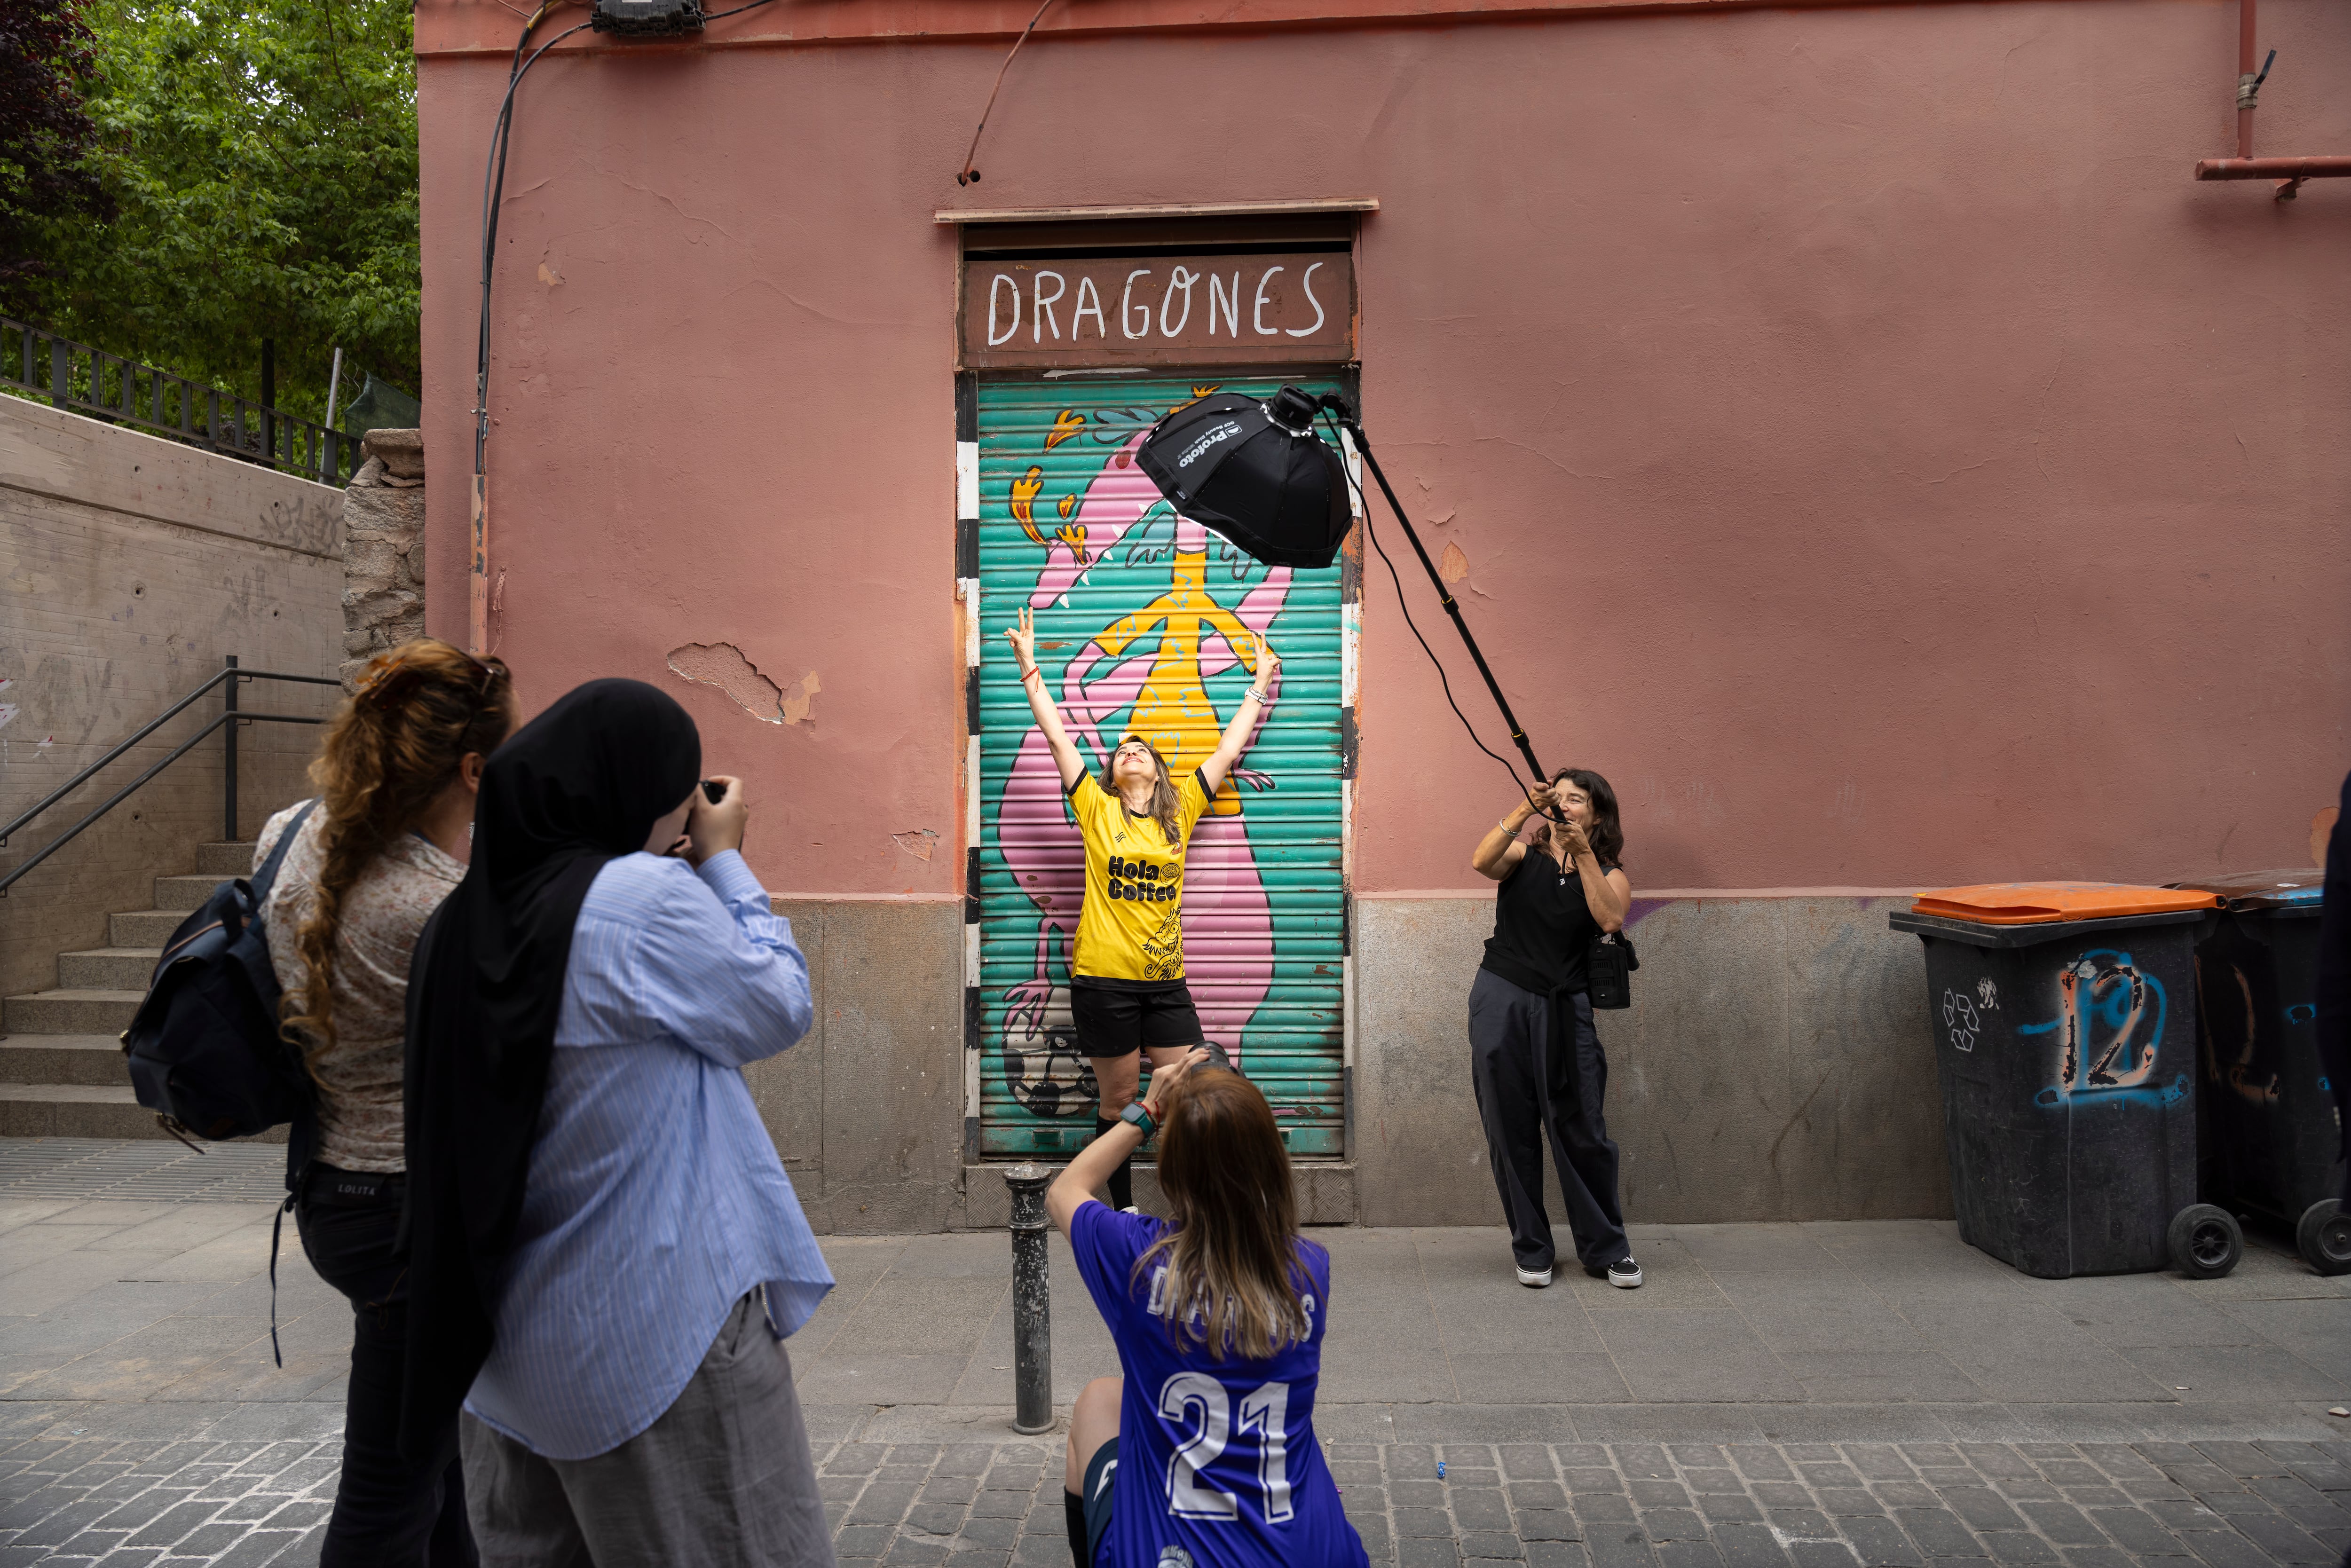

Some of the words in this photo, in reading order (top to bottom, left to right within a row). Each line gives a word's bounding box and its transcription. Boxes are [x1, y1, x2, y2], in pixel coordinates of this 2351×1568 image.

[988, 262, 1325, 346] DRAGONES
[1194, 435, 1206, 444] Dish
[1205, 425, 1223, 436] Beauty
[1179, 430, 1228, 468] Profoto
[1108, 855, 1160, 880] Hola
[1108, 878, 1176, 902] Coffee
[338, 1183, 375, 1196] LOLITA
[1158, 1371, 1294, 1524] 21
